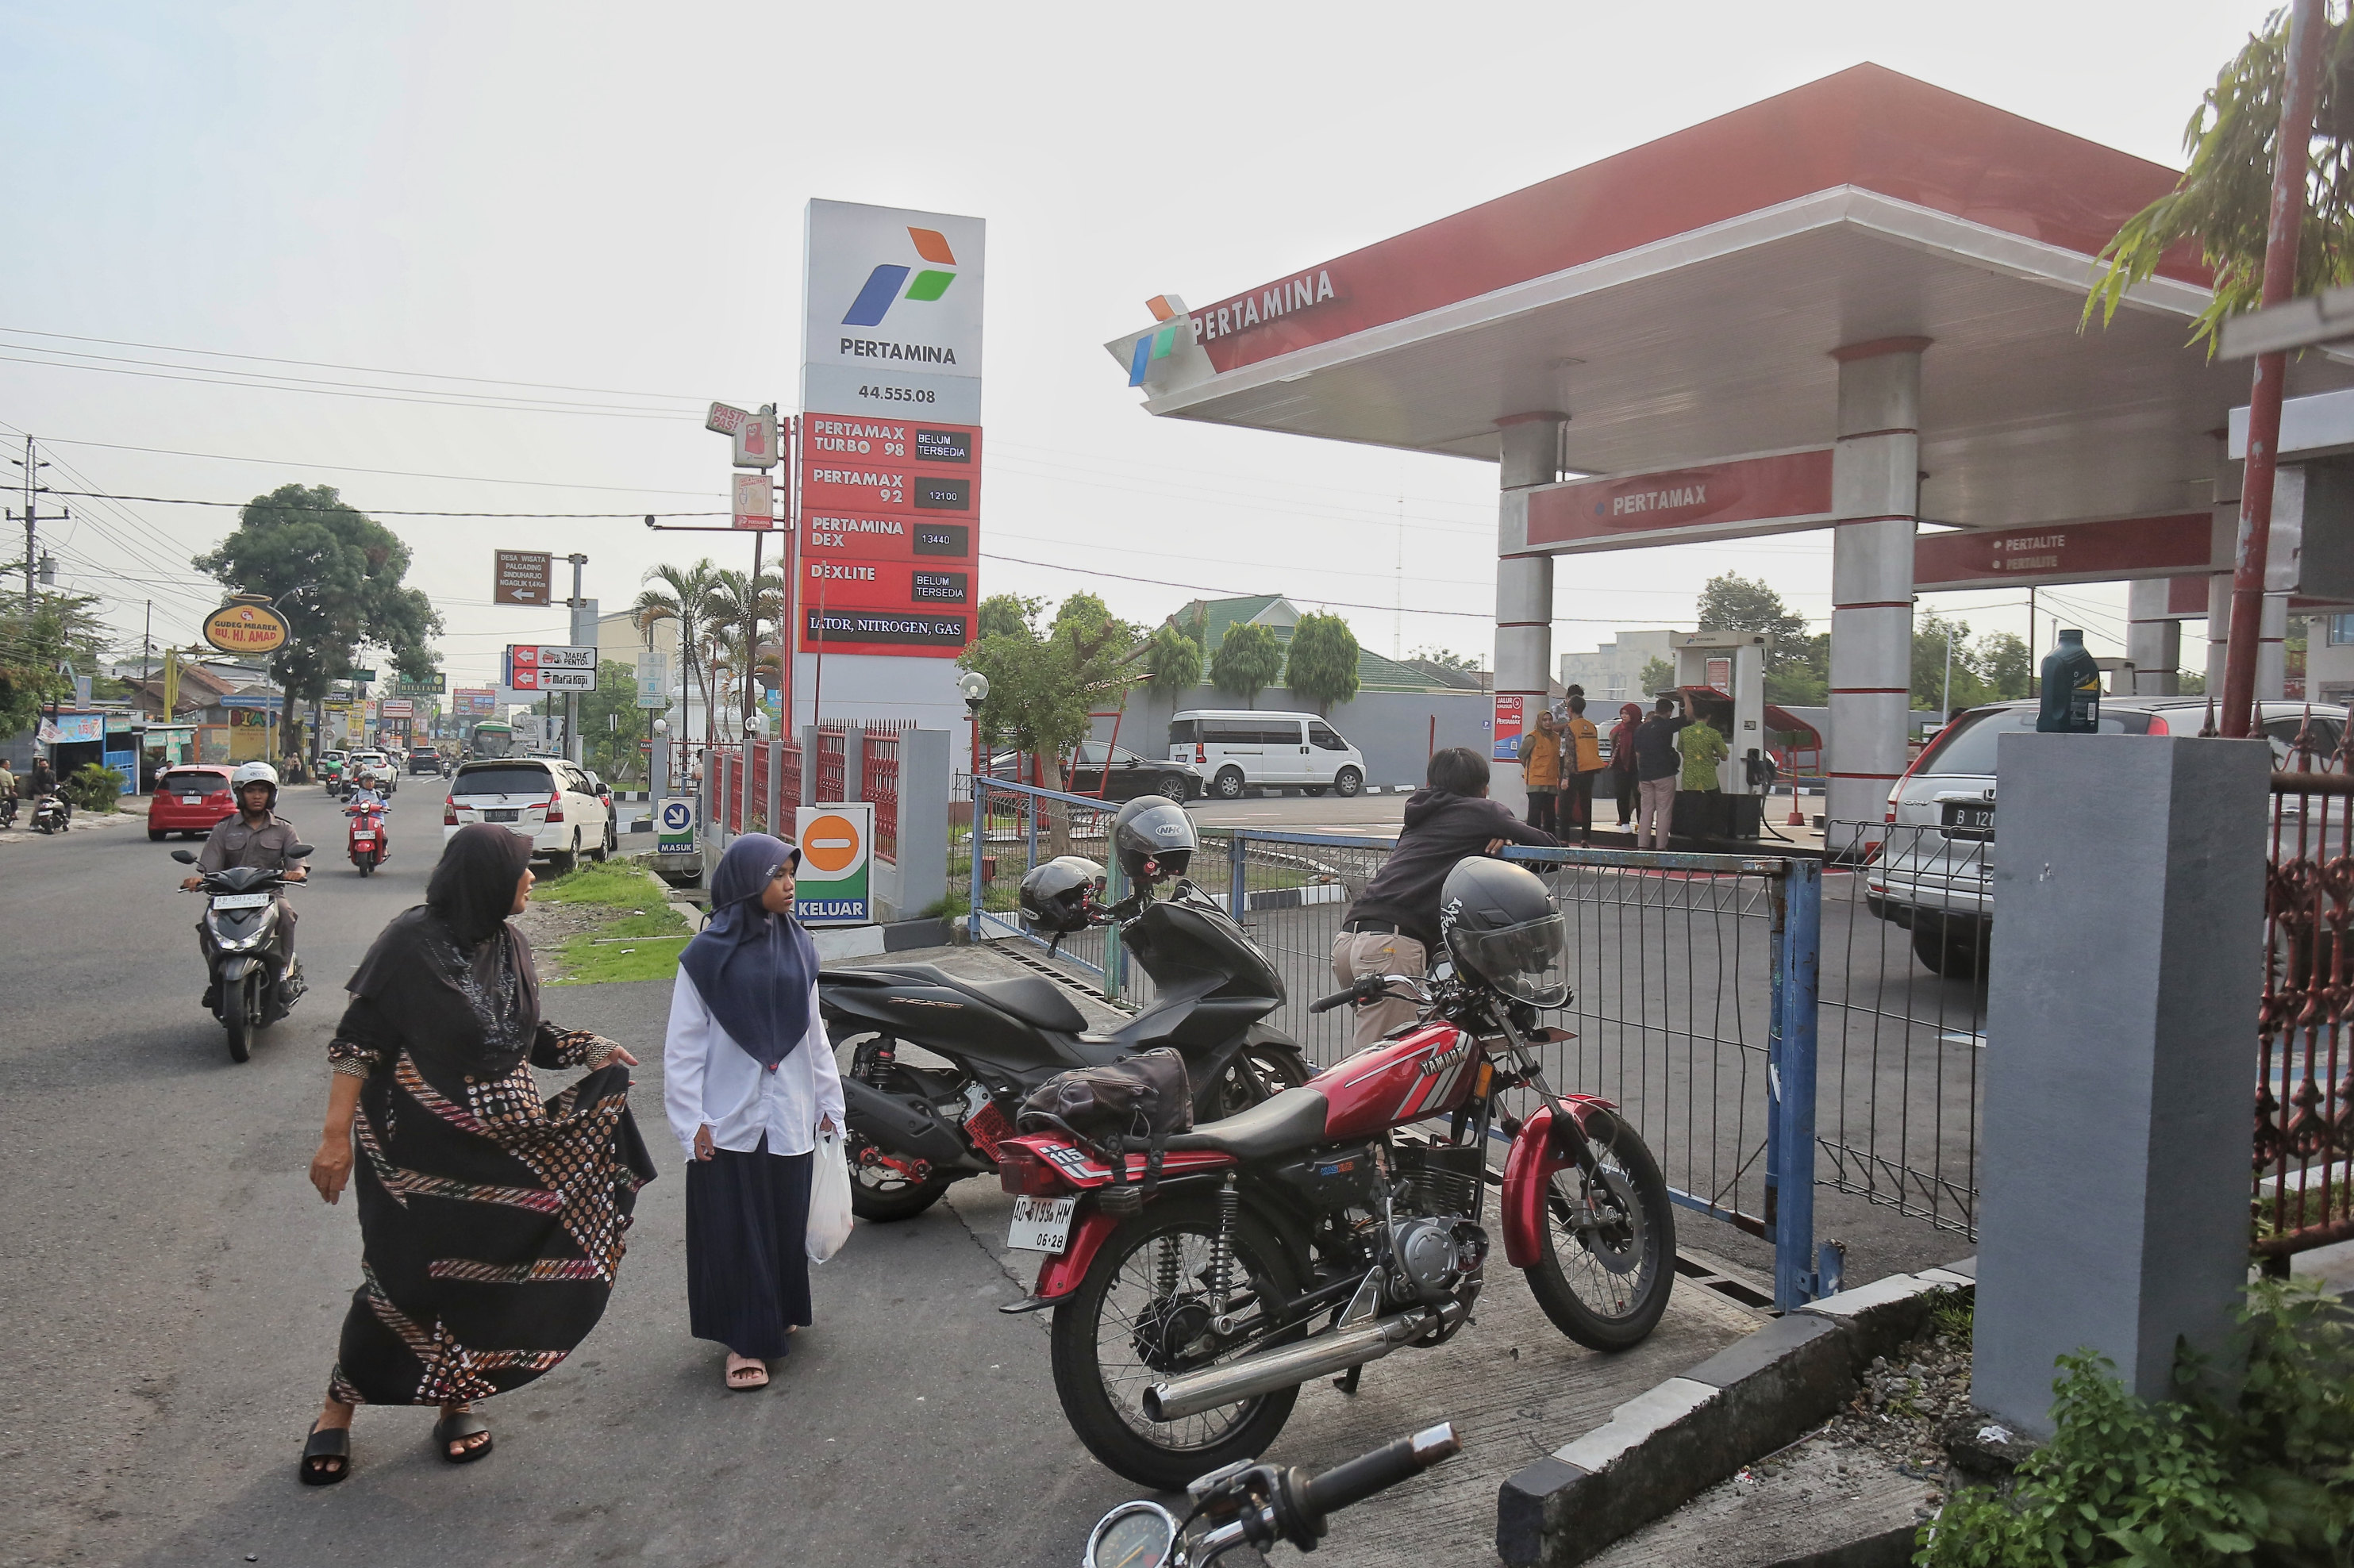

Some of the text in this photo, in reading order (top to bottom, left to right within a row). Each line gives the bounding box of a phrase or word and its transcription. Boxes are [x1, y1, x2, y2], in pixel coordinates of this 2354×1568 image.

[1193, 270, 1335, 345] PERTAMINA
[840, 337, 956, 365] PERTAMINA
[858, 386, 936, 403] 44.555.08
[714, 405, 747, 423] PASTI
[711, 416, 738, 432] PAS!
[814, 421, 906, 440] PERTAMAX
[814, 437, 906, 457] TURBO 98
[918, 434, 951, 445] BELUM
[917, 445, 965, 458] TERSEDIA
[814, 469, 904, 488] PERTAMAX
[880, 489, 903, 503] 92
[929, 491, 957, 501] 12100
[1613, 484, 1707, 516] PERTAMAX
[812, 517, 904, 535] PERTAMINA
[812, 532, 844, 548] DEX
[921, 534, 950, 544] 13440
[2006, 535, 2065, 551] PERTALITE
[506, 563, 542, 571] PALGADING
[2006, 555, 2057, 570] PERTALITE
[811, 564, 875, 580] DEXLITE
[917, 576, 949, 586] BELUM
[916, 586, 964, 598] TERSEDIA
[215, 628, 276, 642] BU. HJ. AMAD
[857, 619, 932, 636] NITROGEN,
[935, 623, 961, 635] GAS
[1956, 809, 1995, 827] B 121
[798, 901, 864, 917] KELUAR
[1421, 1047, 1466, 1076] YAMAHA
[1049, 1147, 1086, 1165] 115
[1320, 1162, 1355, 1176] KASKUS
[1014, 1201, 1026, 1222] AD
[1055, 1202, 1072, 1224] HM
